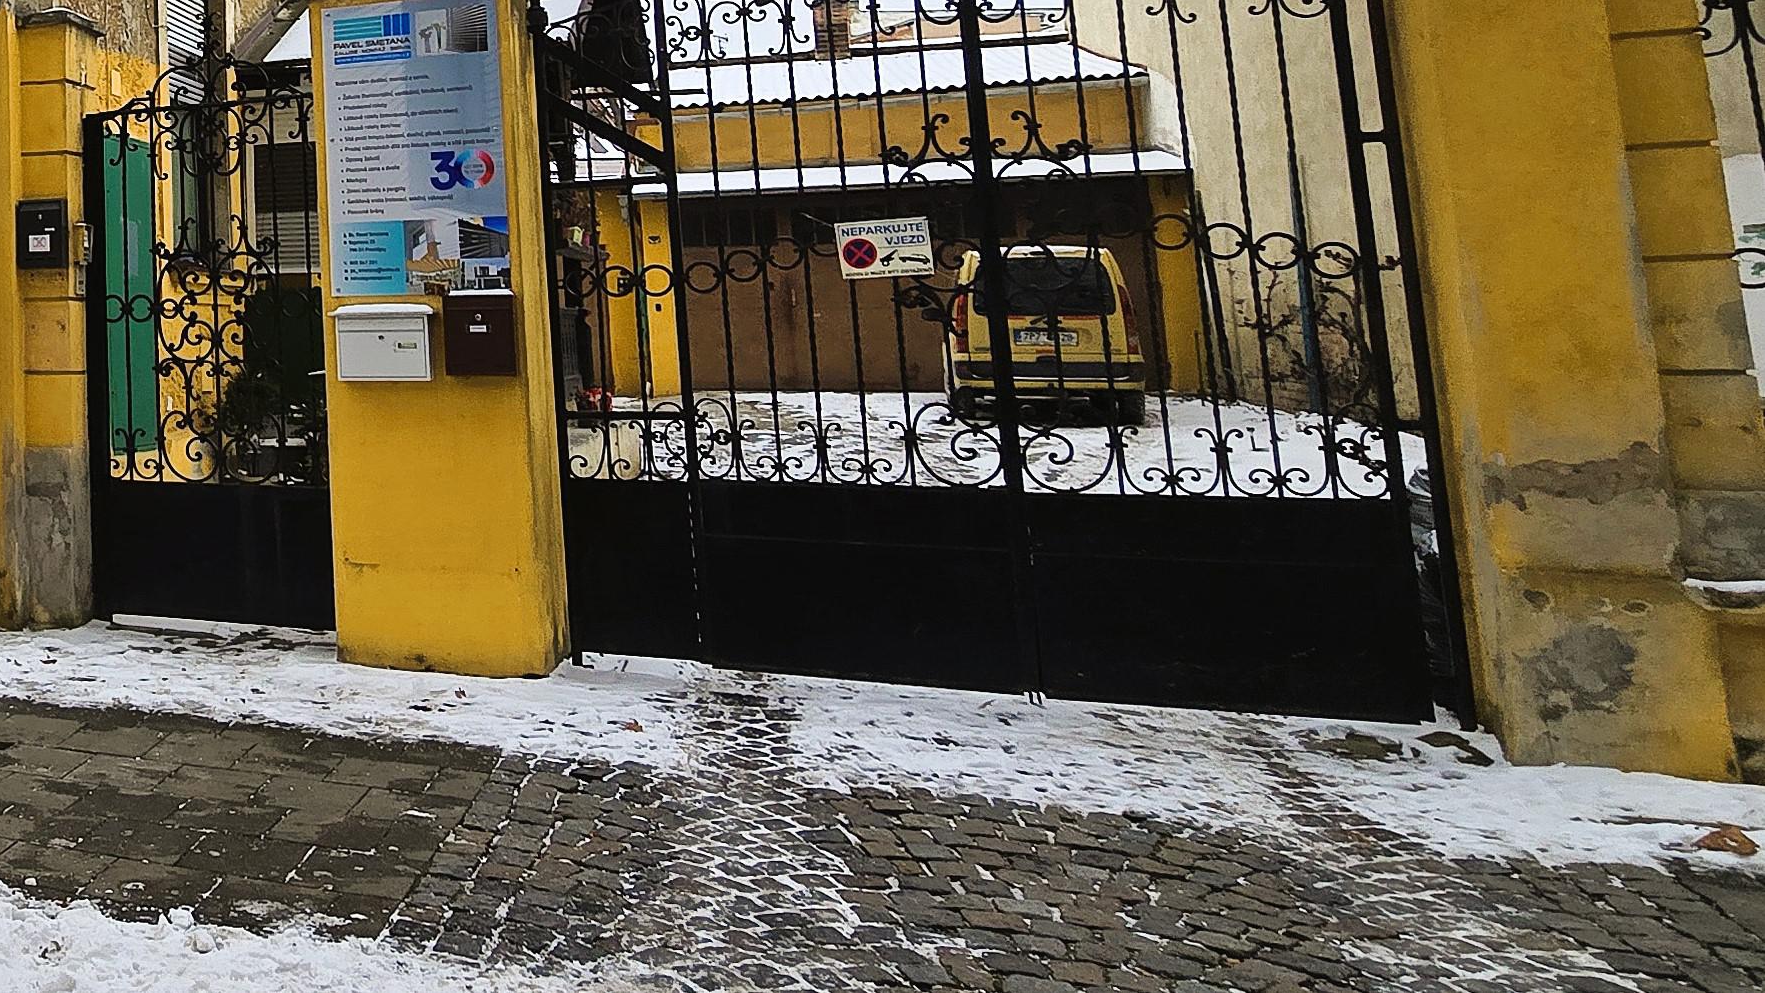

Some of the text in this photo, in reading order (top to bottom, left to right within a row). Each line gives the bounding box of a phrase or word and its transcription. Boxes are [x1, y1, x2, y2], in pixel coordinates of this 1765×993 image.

[333, 37, 411, 50] PAVEL SMETANA
[430, 150, 495, 190] 30
[841, 222, 924, 237] NEPARKUJTE
[884, 235, 925, 245] VJEZD
